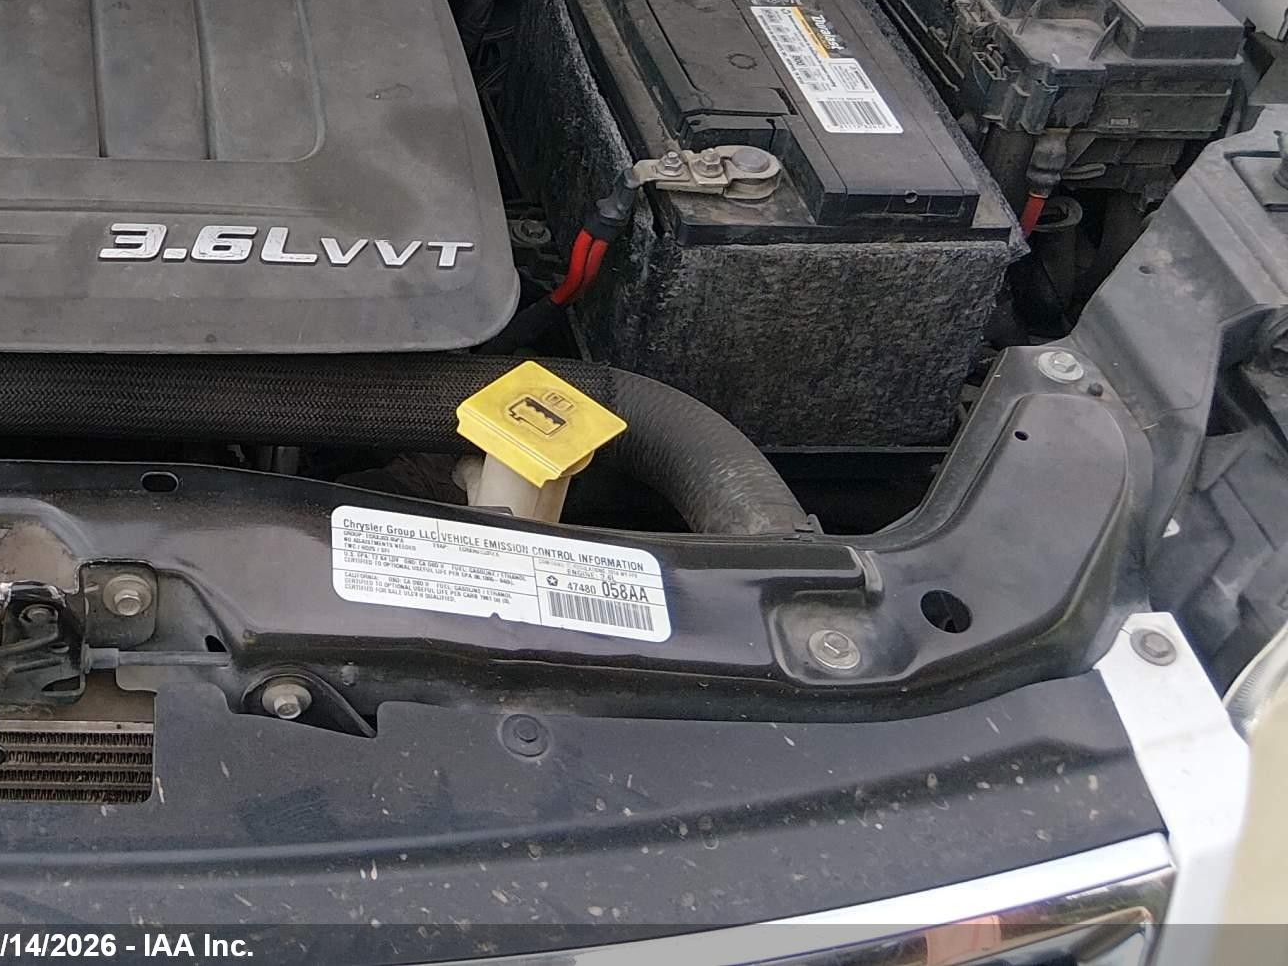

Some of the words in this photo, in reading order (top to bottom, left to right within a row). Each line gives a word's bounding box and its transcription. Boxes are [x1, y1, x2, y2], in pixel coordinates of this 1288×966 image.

[811, 14, 845, 51] Duralast
[344, 519, 383, 532] Chrysler
[386, 525, 415, 537] Group
[419, 531, 436, 540] LLC
[441, 533, 479, 546] VEHICLE
[484, 539, 528, 554] EMISSION
[532, 546, 575, 561] CONTROL
[579, 554, 644, 571] INFORMATION
[568, 582, 597, 594] 47480
[602, 581, 649, 602] 058AA
